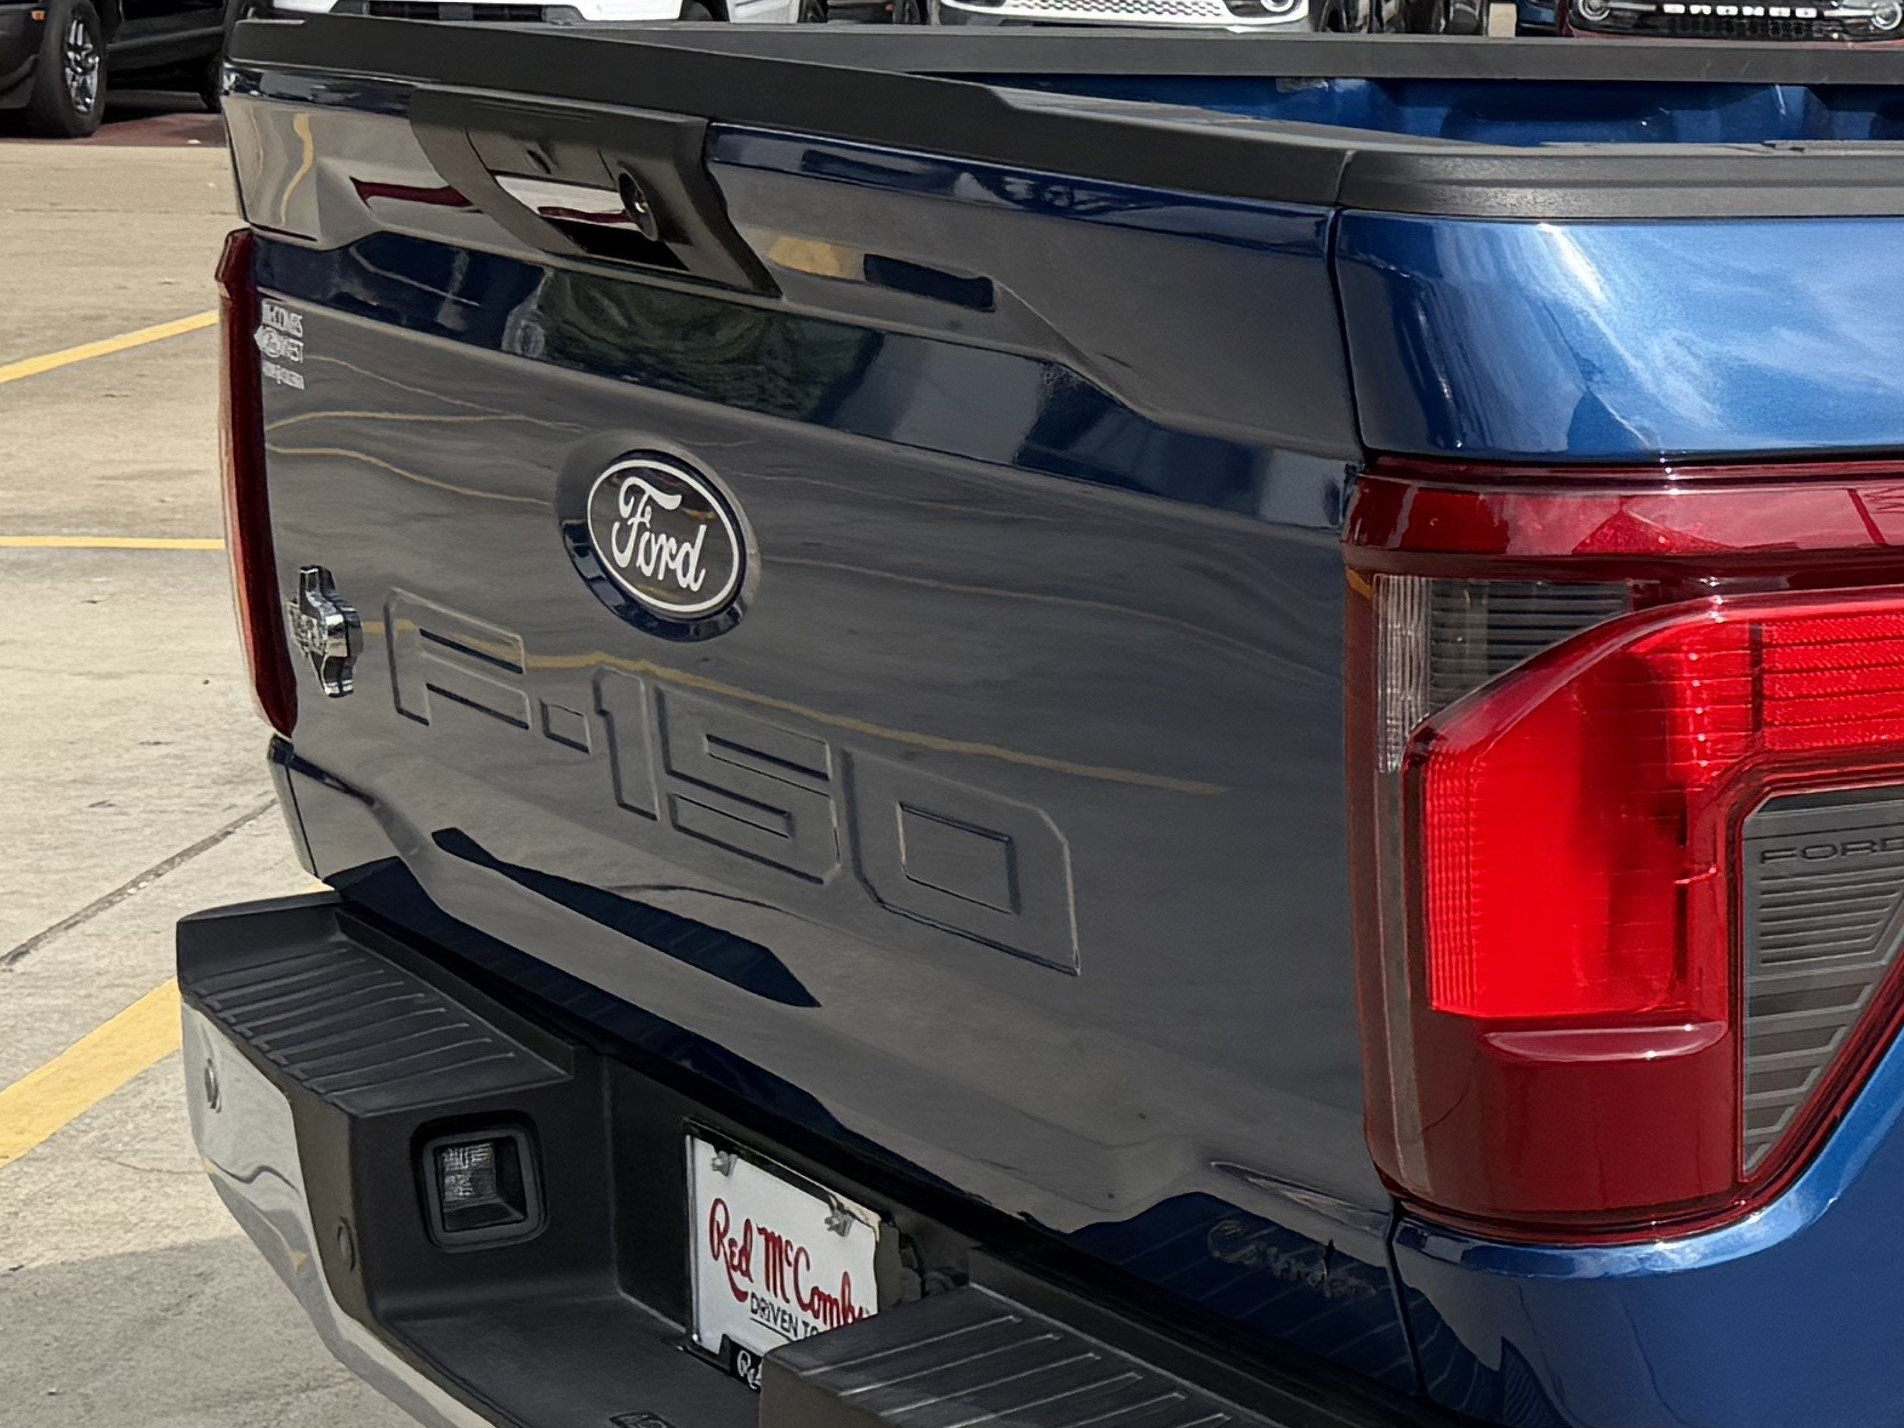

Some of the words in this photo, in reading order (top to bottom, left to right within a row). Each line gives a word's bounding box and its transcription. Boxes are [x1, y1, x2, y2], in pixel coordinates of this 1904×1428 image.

[611, 476, 708, 592] Ford
[709, 1198, 754, 1303] Red
[750, 1292, 799, 1338] DRIVEN
